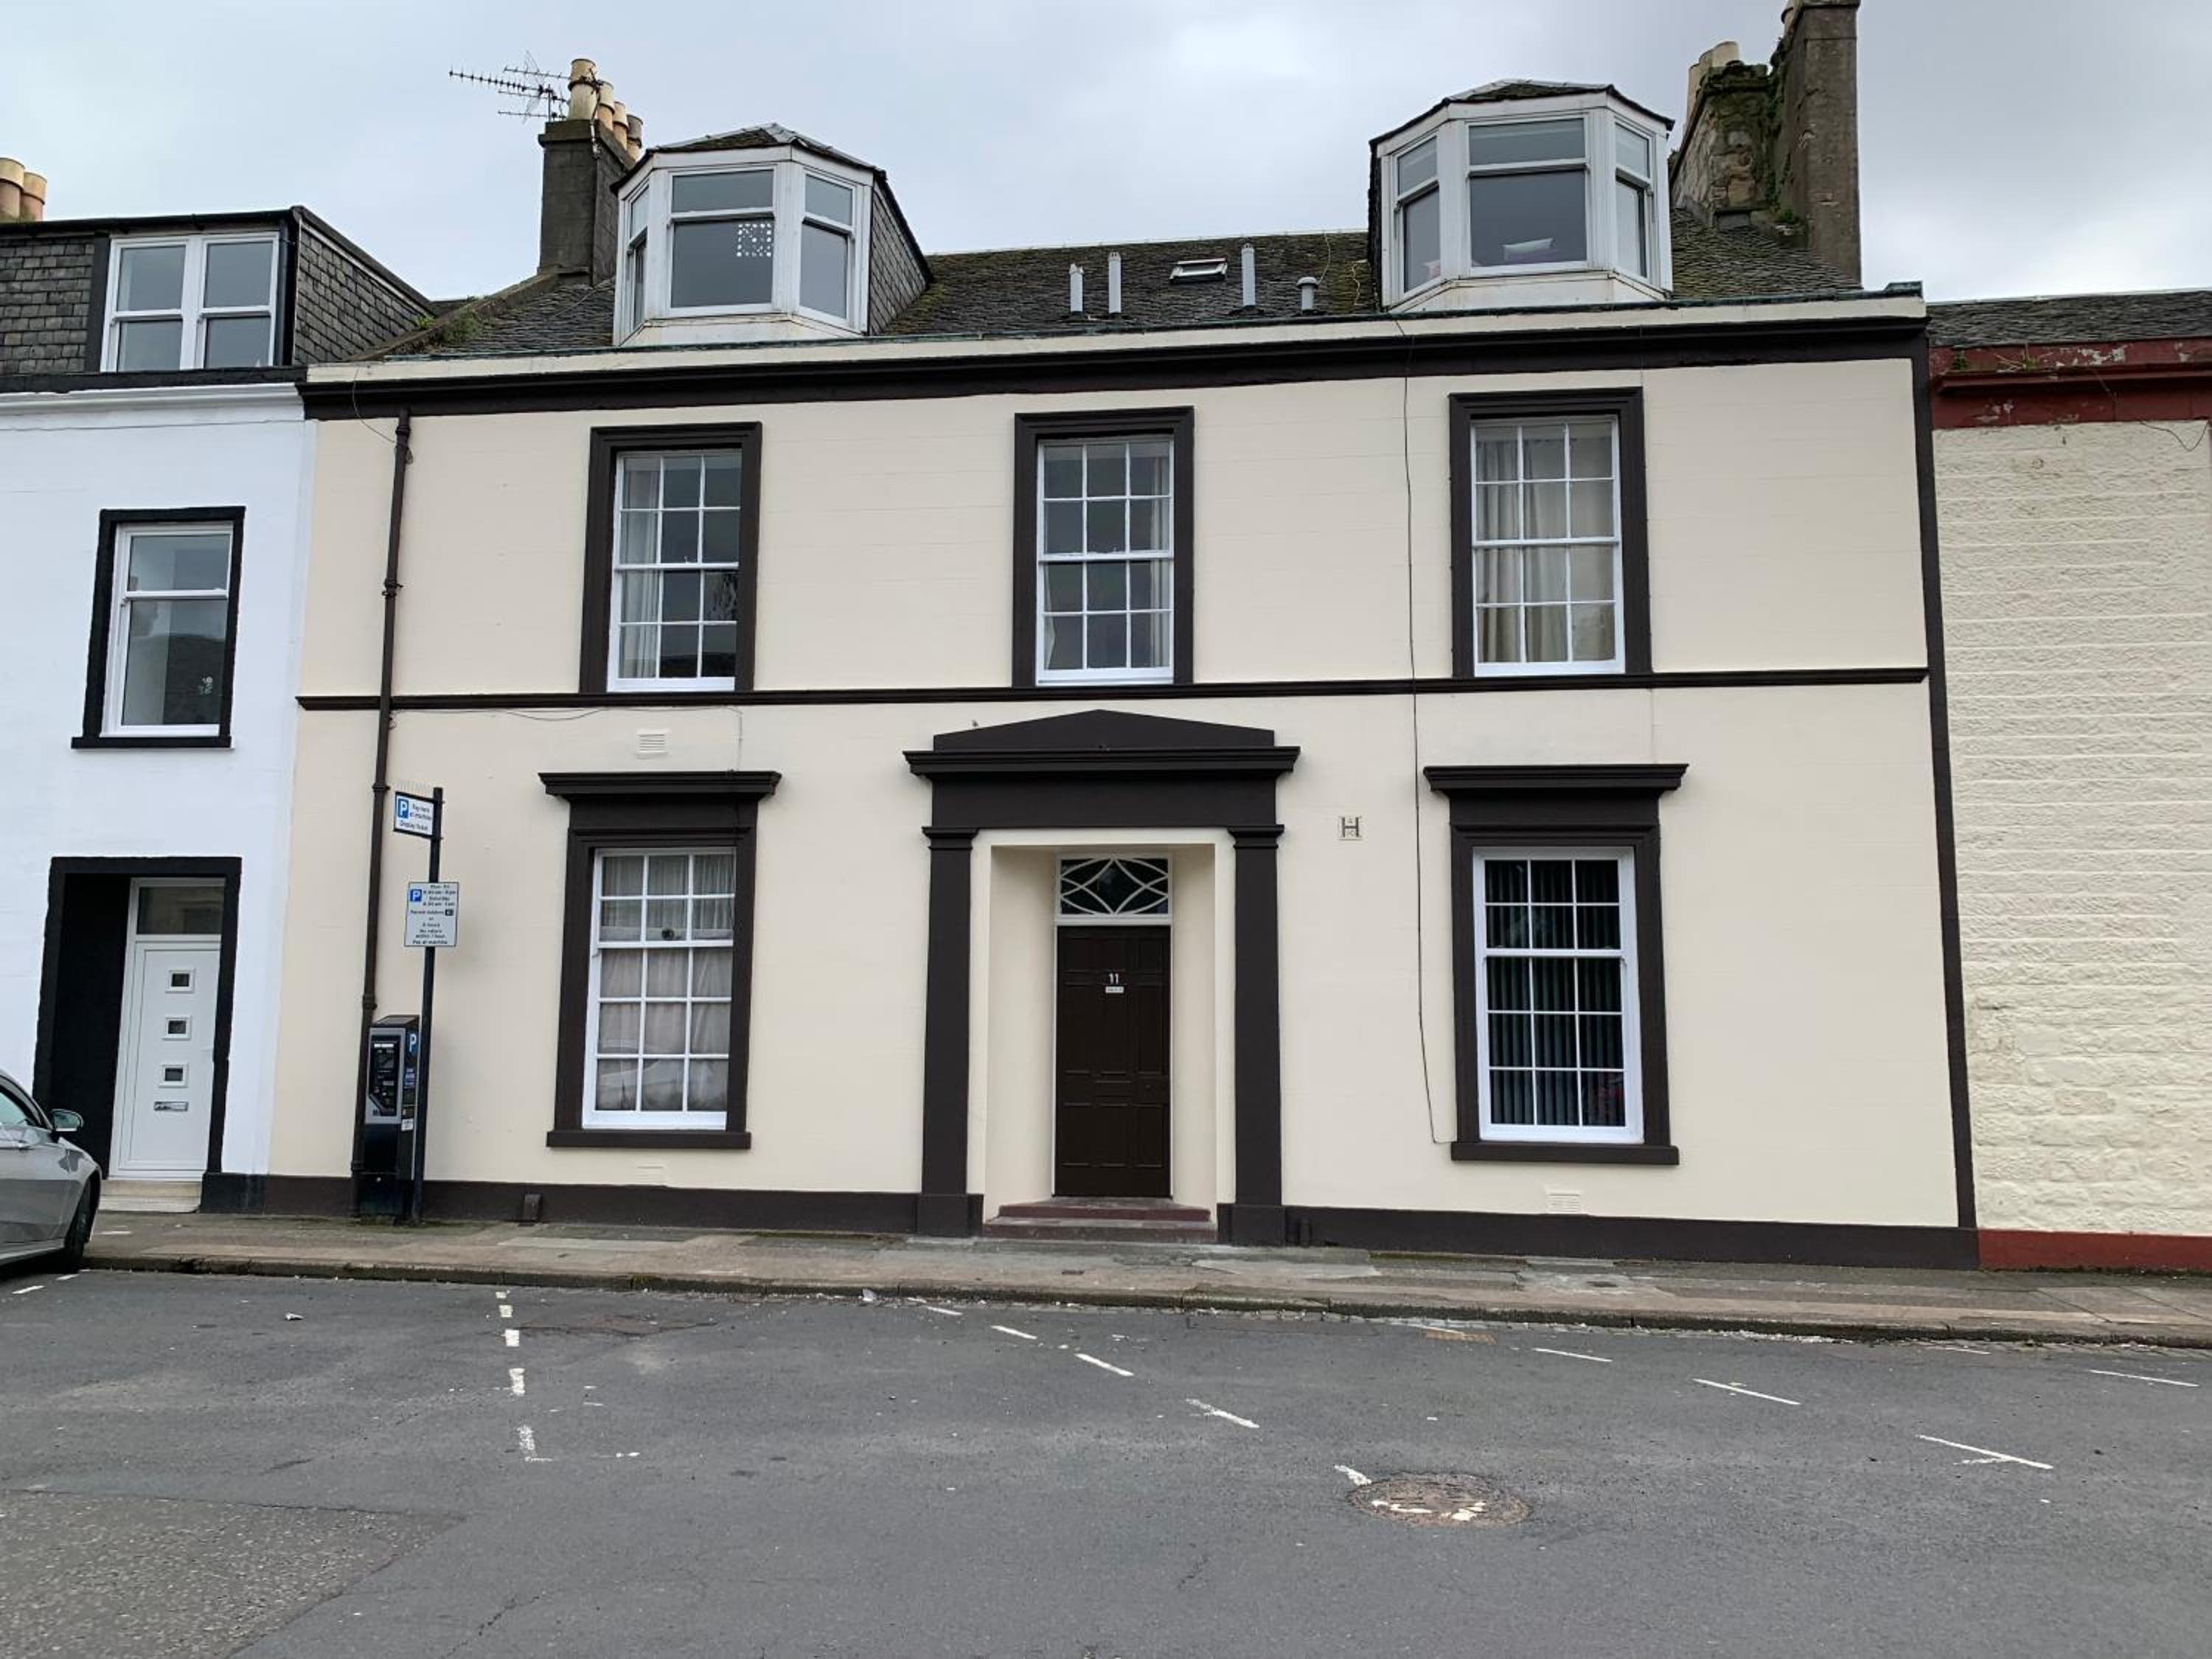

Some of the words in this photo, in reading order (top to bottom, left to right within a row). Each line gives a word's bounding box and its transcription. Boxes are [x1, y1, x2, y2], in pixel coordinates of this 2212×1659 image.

[400, 800, 408, 817] P
[1341, 816, 1360, 838] H
[1108, 973, 1119, 985] 11
[408, 1033, 417, 1053] P
